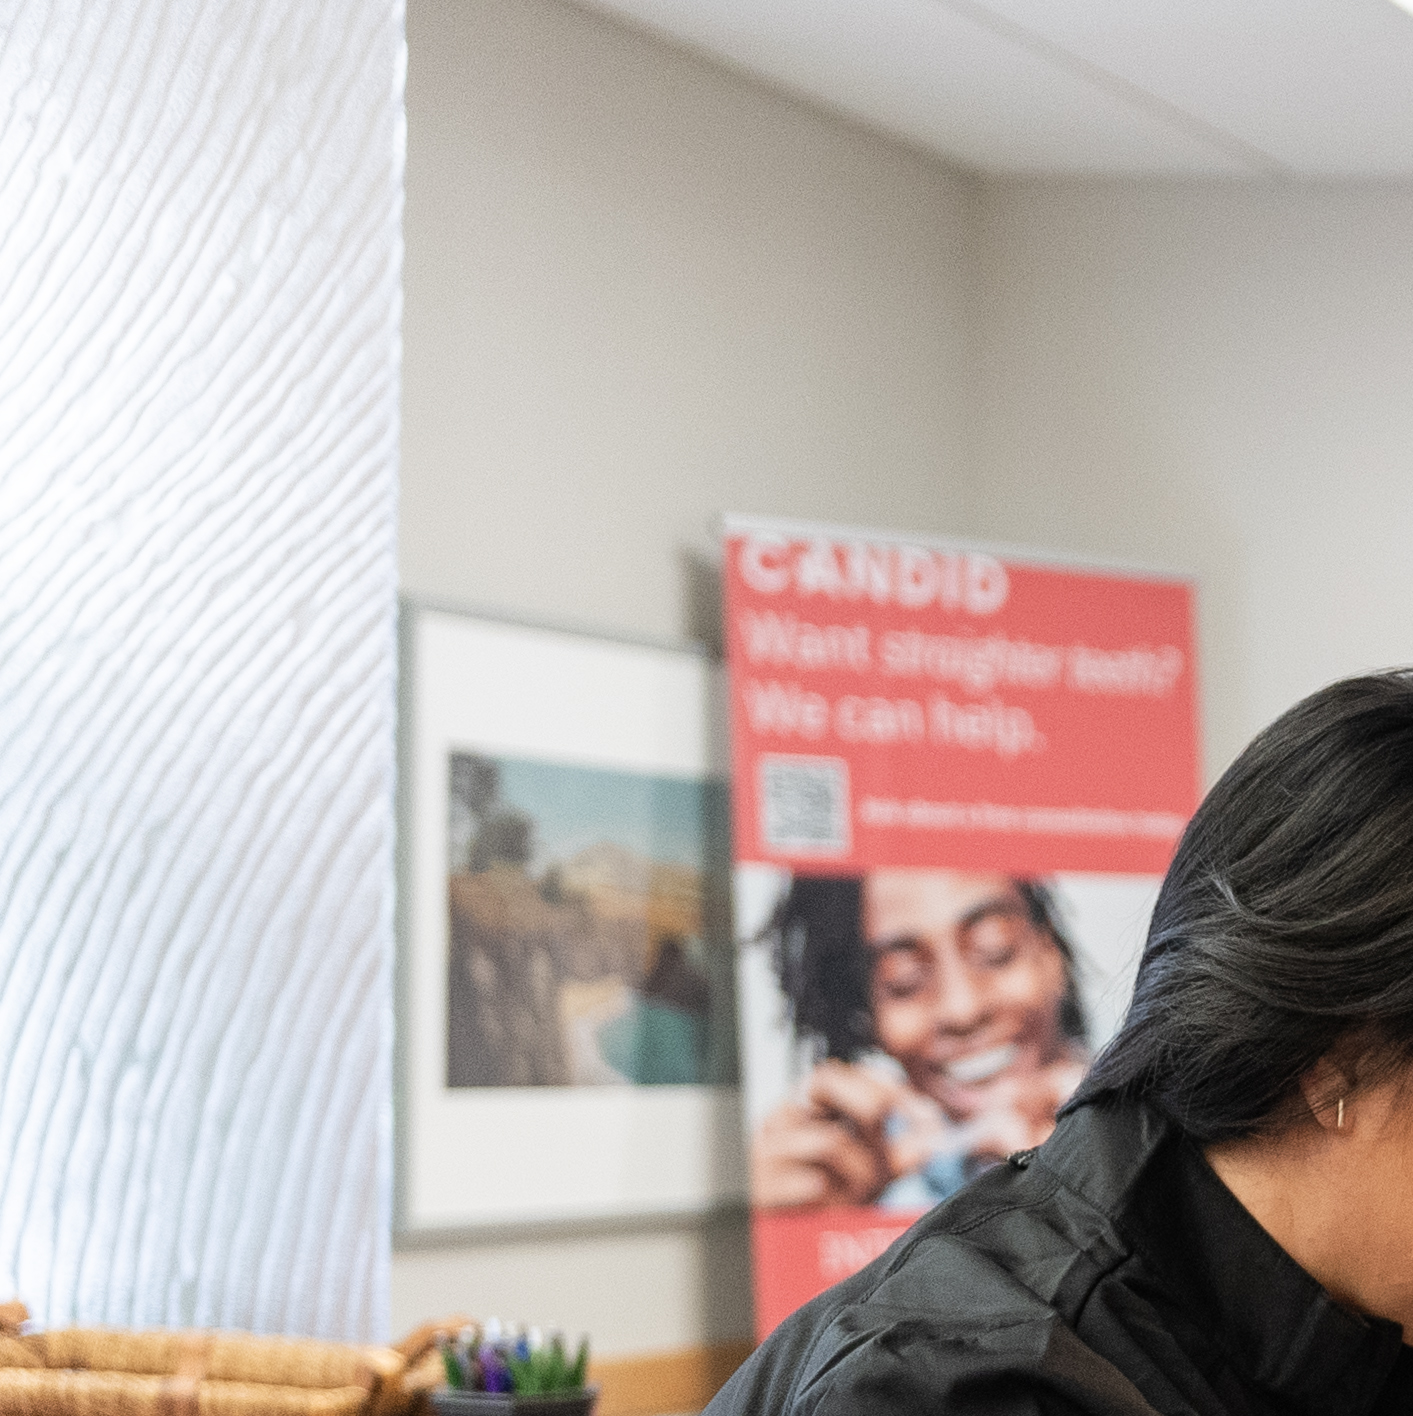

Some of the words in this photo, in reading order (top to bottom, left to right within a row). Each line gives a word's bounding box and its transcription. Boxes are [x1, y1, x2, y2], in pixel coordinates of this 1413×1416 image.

[740, 530, 1009, 614] CANDID
[742, 612, 870, 673] Want
[746, 681, 829, 738] We
[836, 697, 924, 742] can
[930, 692, 1046, 756] help.
